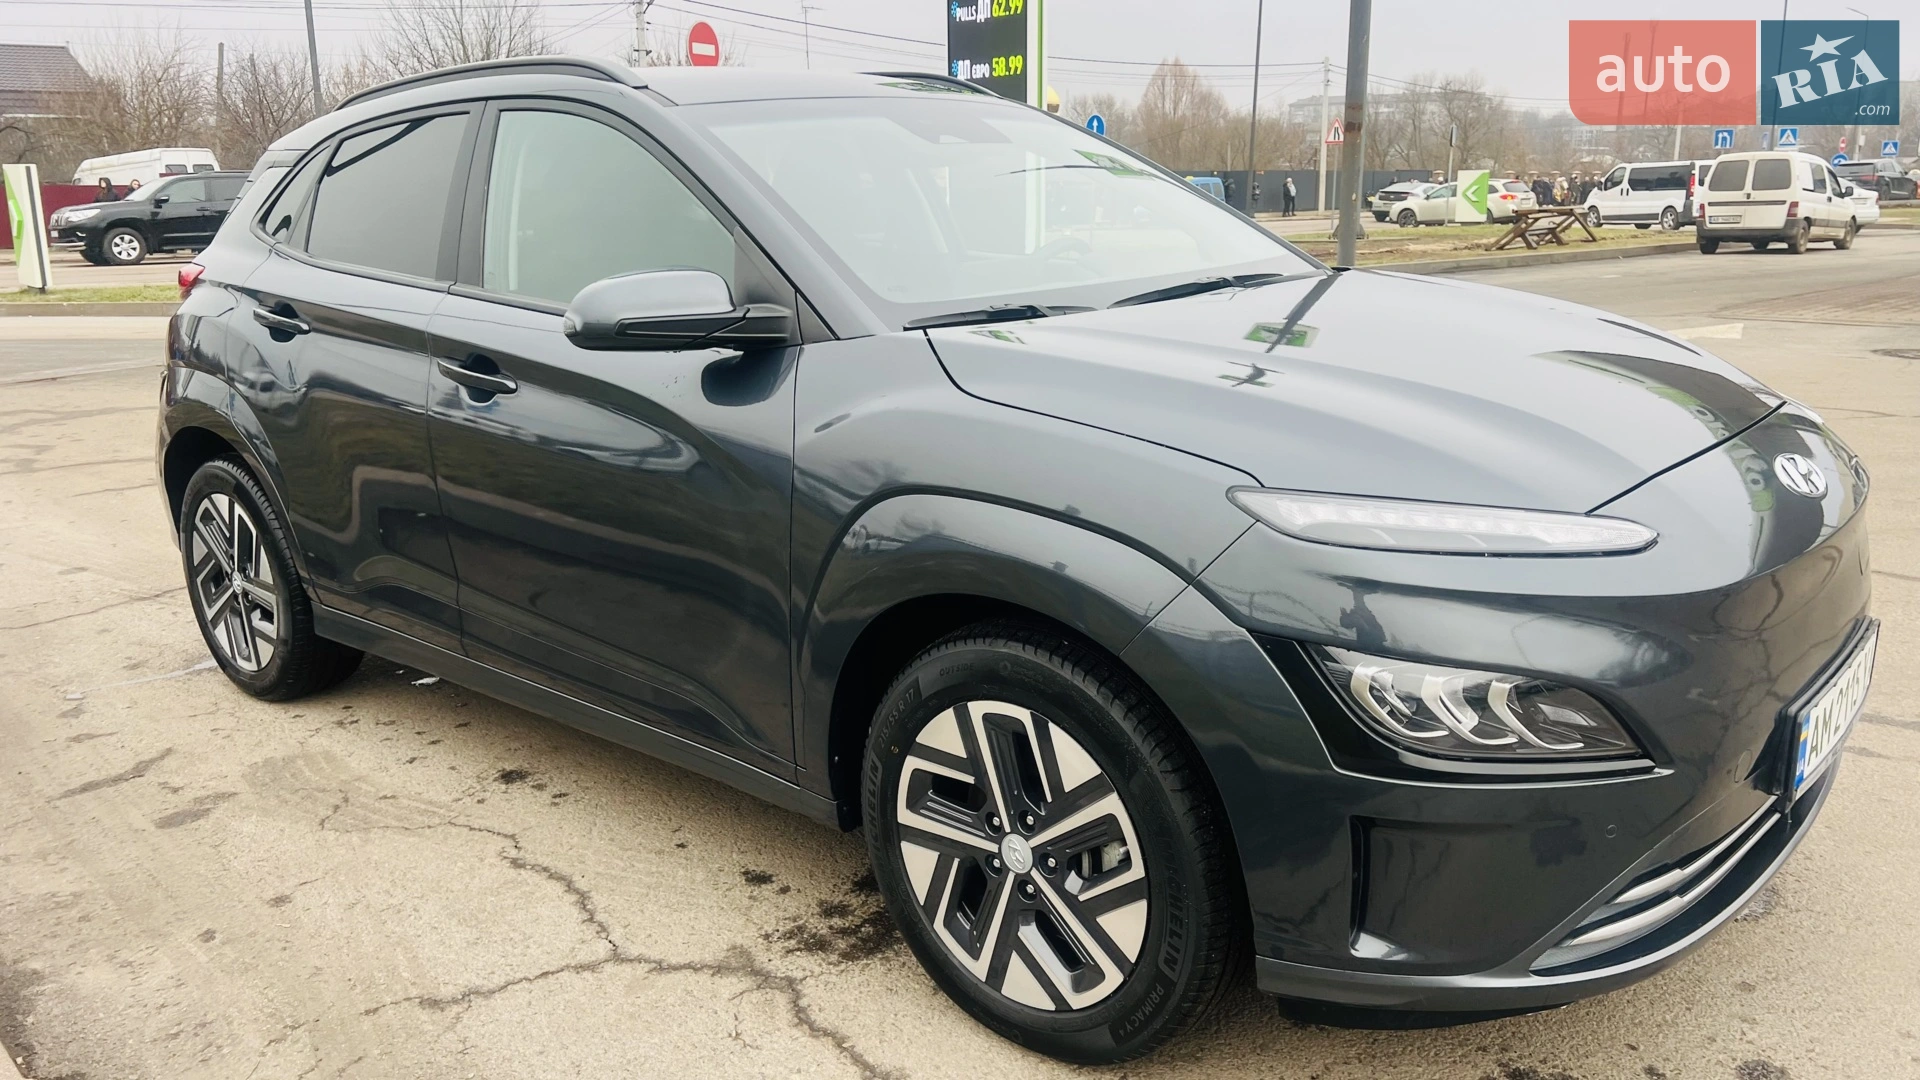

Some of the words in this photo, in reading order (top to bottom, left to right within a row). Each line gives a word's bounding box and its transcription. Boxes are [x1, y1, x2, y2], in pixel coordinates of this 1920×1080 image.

[956, 5, 977, 21] PULLS
[992, 0, 1023, 17] 62.99
[957, 60, 971, 80] ДП
[992, 55, 1023, 77] 58.99
[939, 663, 975, 677] OUTSIDE
[905, 688, 914, 703] 17
[1123, 983, 1165, 1032] PRIMACY
